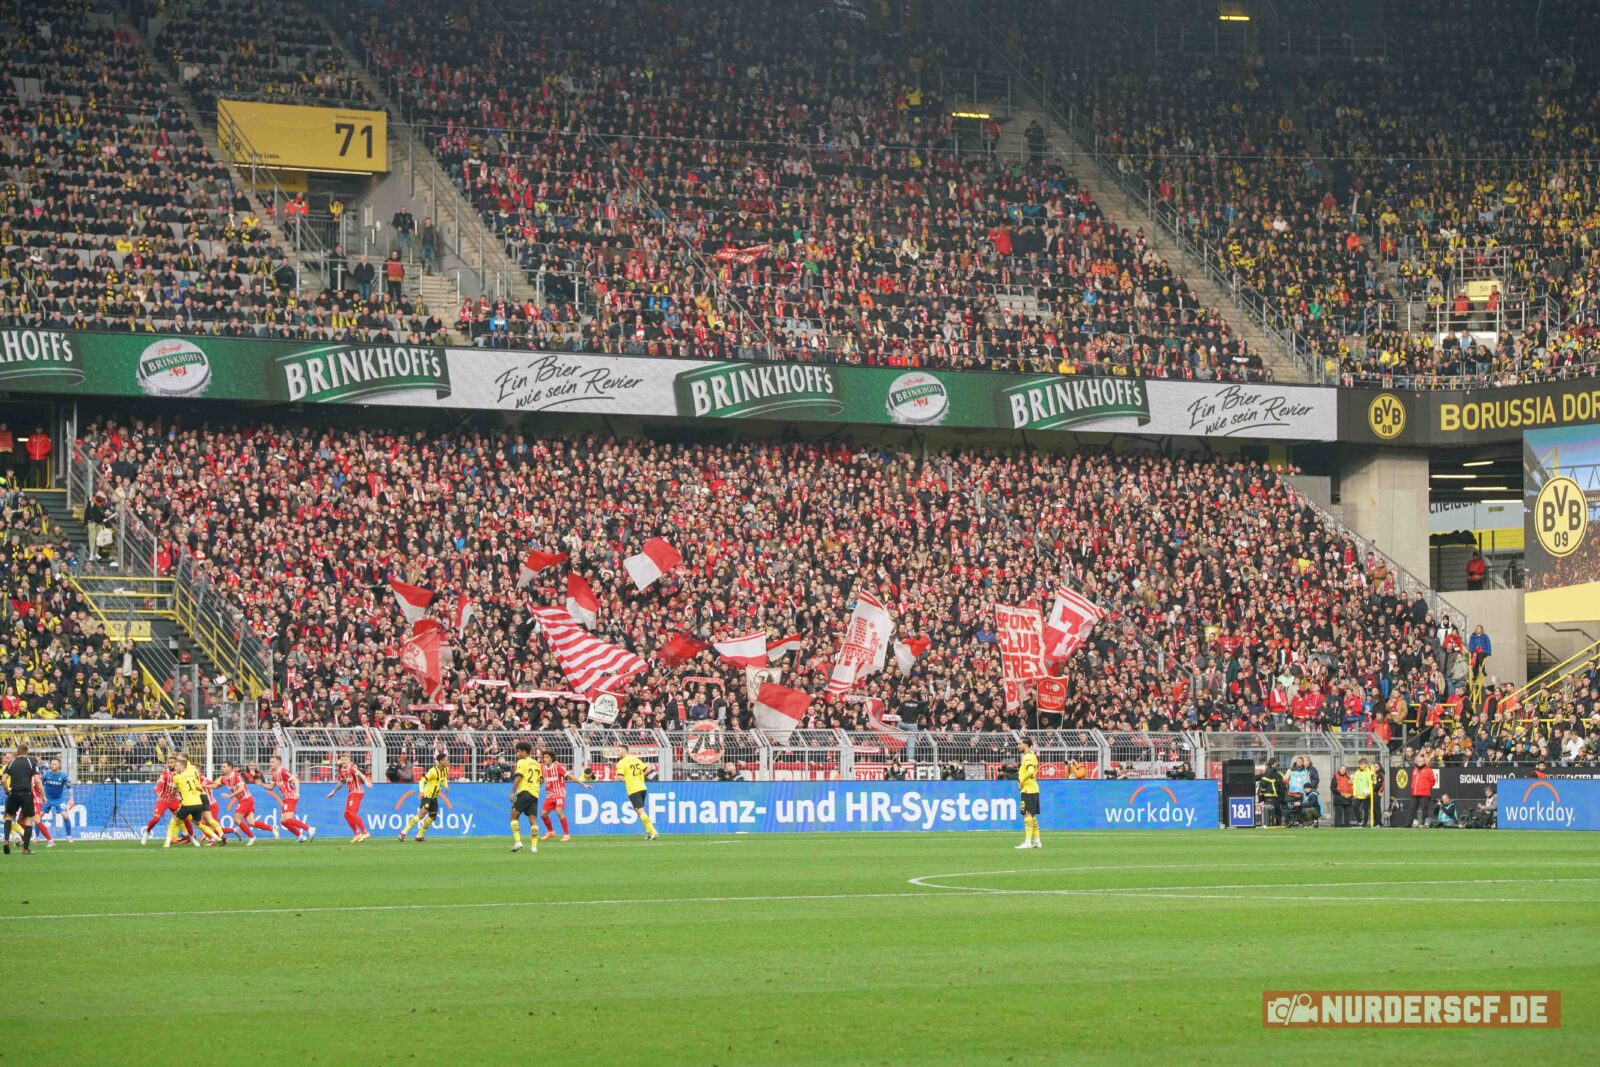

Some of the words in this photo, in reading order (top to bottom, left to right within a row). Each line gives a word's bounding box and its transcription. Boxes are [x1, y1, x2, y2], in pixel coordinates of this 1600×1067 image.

[335, 123, 373, 158] 71
[284, 346, 442, 401] BRINKHOFF's
[495, 367, 527, 403] Ein
[528, 355, 581, 383] Bier
[515, 383, 541, 409] wie
[547, 379, 577, 398] sein
[583, 367, 643, 395] Revier
[690, 365, 833, 417] BRINKHOFF's
[1010, 378, 1143, 429] BRINKHOFF's
[1187, 397, 1217, 428] Ein
[1211, 385, 1261, 410] Bier
[1204, 408, 1228, 435] wie
[1230, 407, 1258, 425] sein
[1261, 396, 1314, 420] Revier
[1374, 399, 1402, 425] BVB
[1441, 395, 1557, 431] BORUSSIA
[1382, 424, 1393, 434] 09
[1543, 485, 1582, 532] BVB
[1554, 531, 1569, 548] 09
[527, 768, 541, 783] 27
[629, 763, 643, 777] 25
[1460, 774, 1485, 784] SIGNAL
[575, 793, 638, 825] Das
[649, 791, 766, 824] Finanz-
[776, 791, 836, 823] und
[846, 791, 1017, 829] HR-System
[1231, 803, 1251, 819] 1&1
